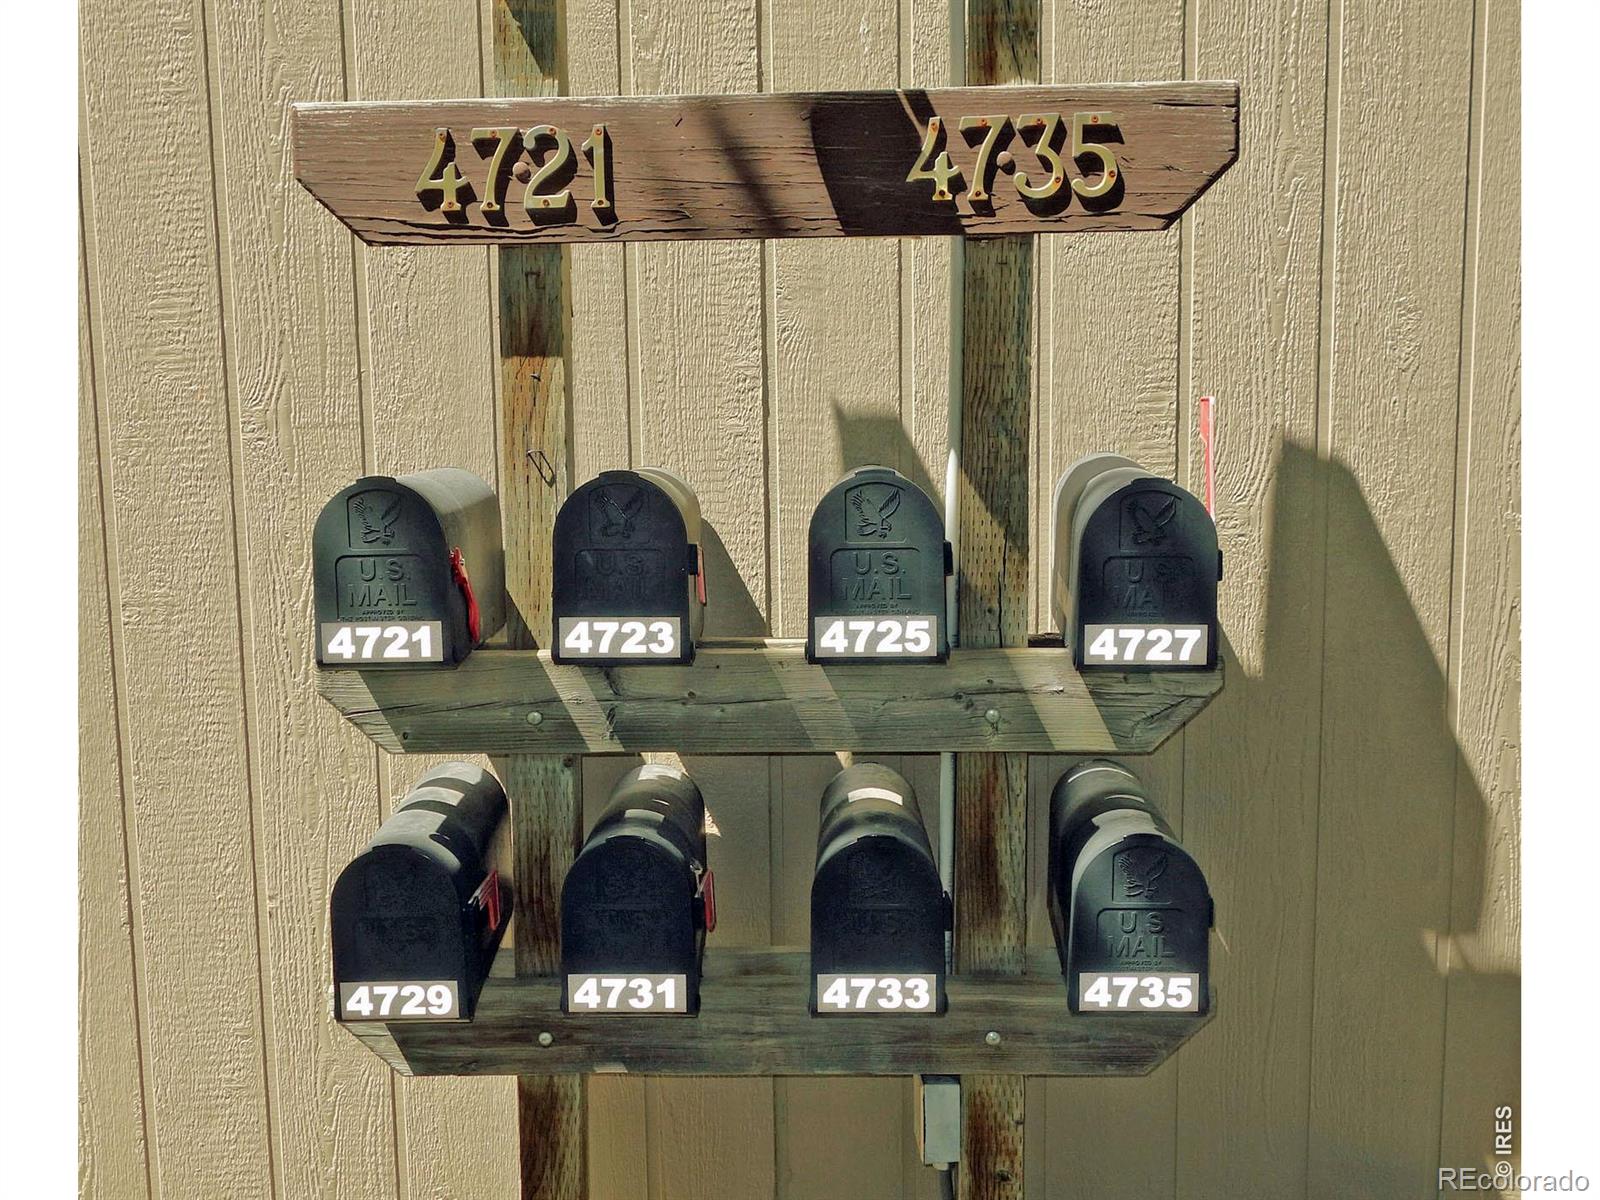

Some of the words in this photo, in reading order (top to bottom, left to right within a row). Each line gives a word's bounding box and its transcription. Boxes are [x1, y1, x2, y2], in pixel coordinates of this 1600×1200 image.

[415, 124, 610, 212] 4721
[905, 110, 1113, 201] 4735
[359, 557, 412, 582] U.S.
[853, 551, 907, 576] U.S.
[347, 582, 418, 608] MAIL
[841, 576, 913, 601] MAIL
[327, 625, 433, 659] 4721
[565, 621, 676, 654] 4723
[819, 620, 931, 653] 4725
[1089, 628, 1202, 661] 4727
[1105, 935, 1177, 958] MAIL
[346, 984, 453, 1016] 4729
[573, 977, 677, 1009] 4731
[822, 977, 931, 1009] 4733
[1084, 976, 1193, 1008] 4735
